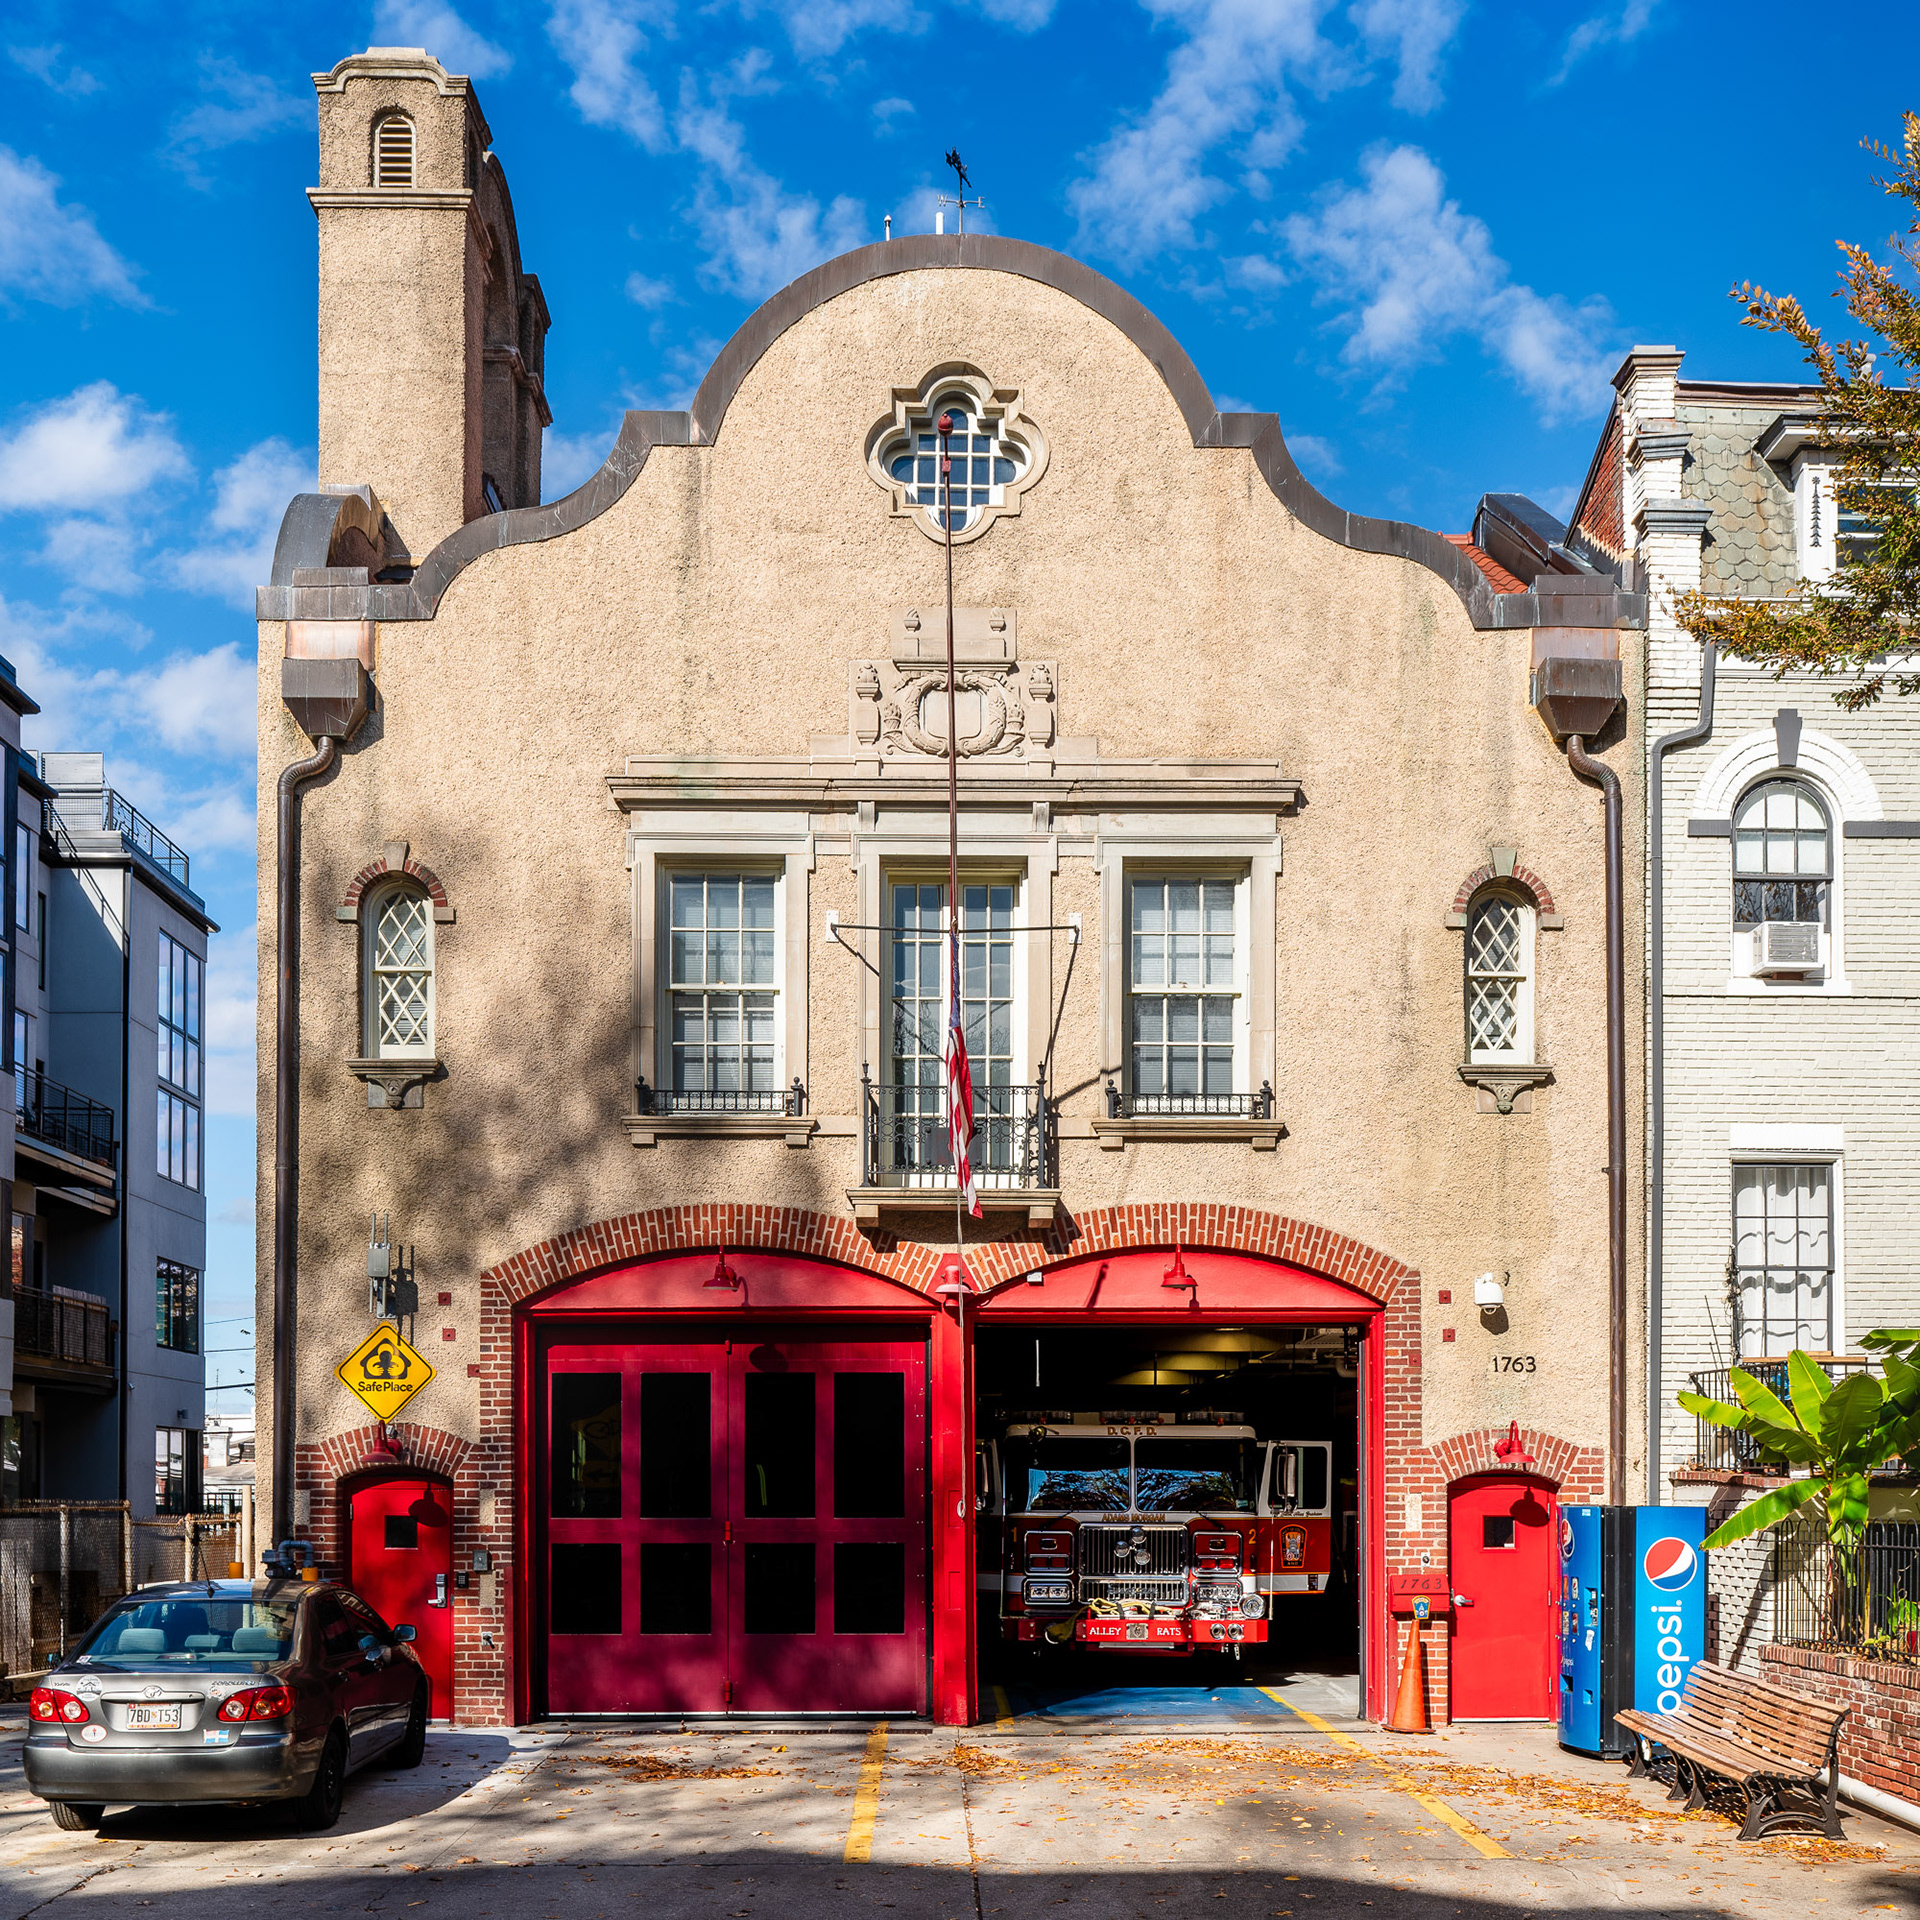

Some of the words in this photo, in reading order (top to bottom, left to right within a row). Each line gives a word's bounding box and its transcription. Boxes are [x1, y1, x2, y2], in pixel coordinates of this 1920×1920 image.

[1492, 1355, 1537, 1374] 1763
[357, 1381, 382, 1392] Safe
[383, 1381, 414, 1392] Place
[1102, 1513, 1130, 1523] ADAMS
[1131, 1513, 1166, 1523] MORGAN
[1010, 1526, 1018, 1543] 1
[1248, 1528, 1257, 1545] 2
[1400, 1578, 1441, 1590] 1763
[1089, 1626, 1122, 1636] ALLEY
[1156, 1626, 1181, 1636] RATS
[130, 1709, 151, 1722] 7BD
[158, 1709, 179, 1722] T53
